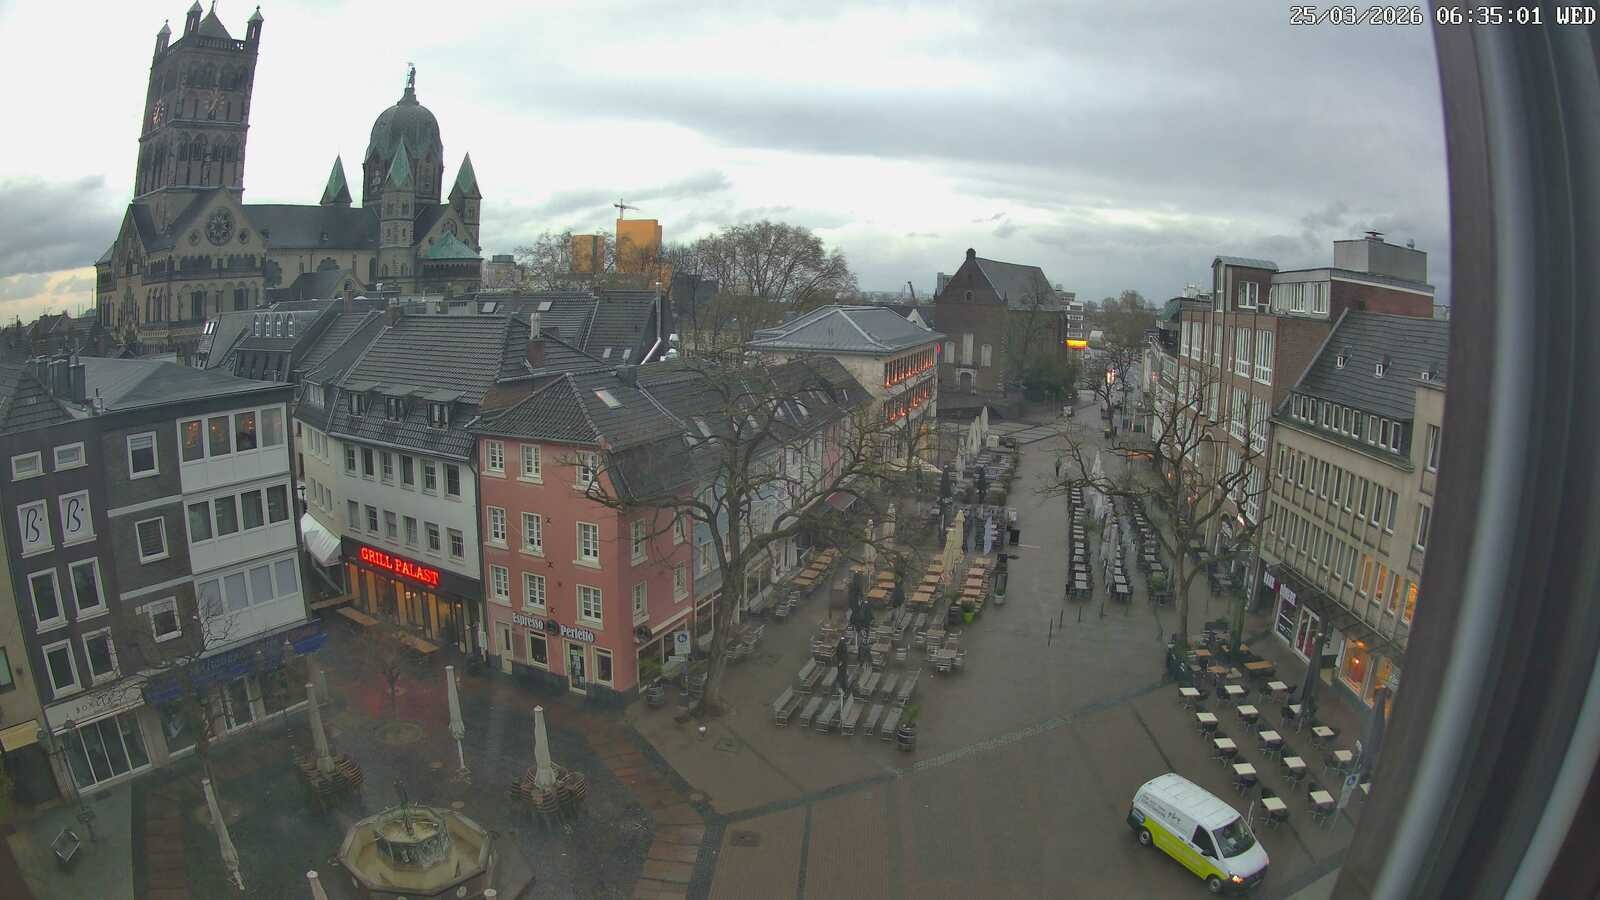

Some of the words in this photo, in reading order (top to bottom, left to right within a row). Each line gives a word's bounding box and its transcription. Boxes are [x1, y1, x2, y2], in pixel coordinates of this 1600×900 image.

[360, 547, 393, 570] GRILL
[394, 558, 439, 586] PALAST
[511, 612, 545, 630] Espresso
